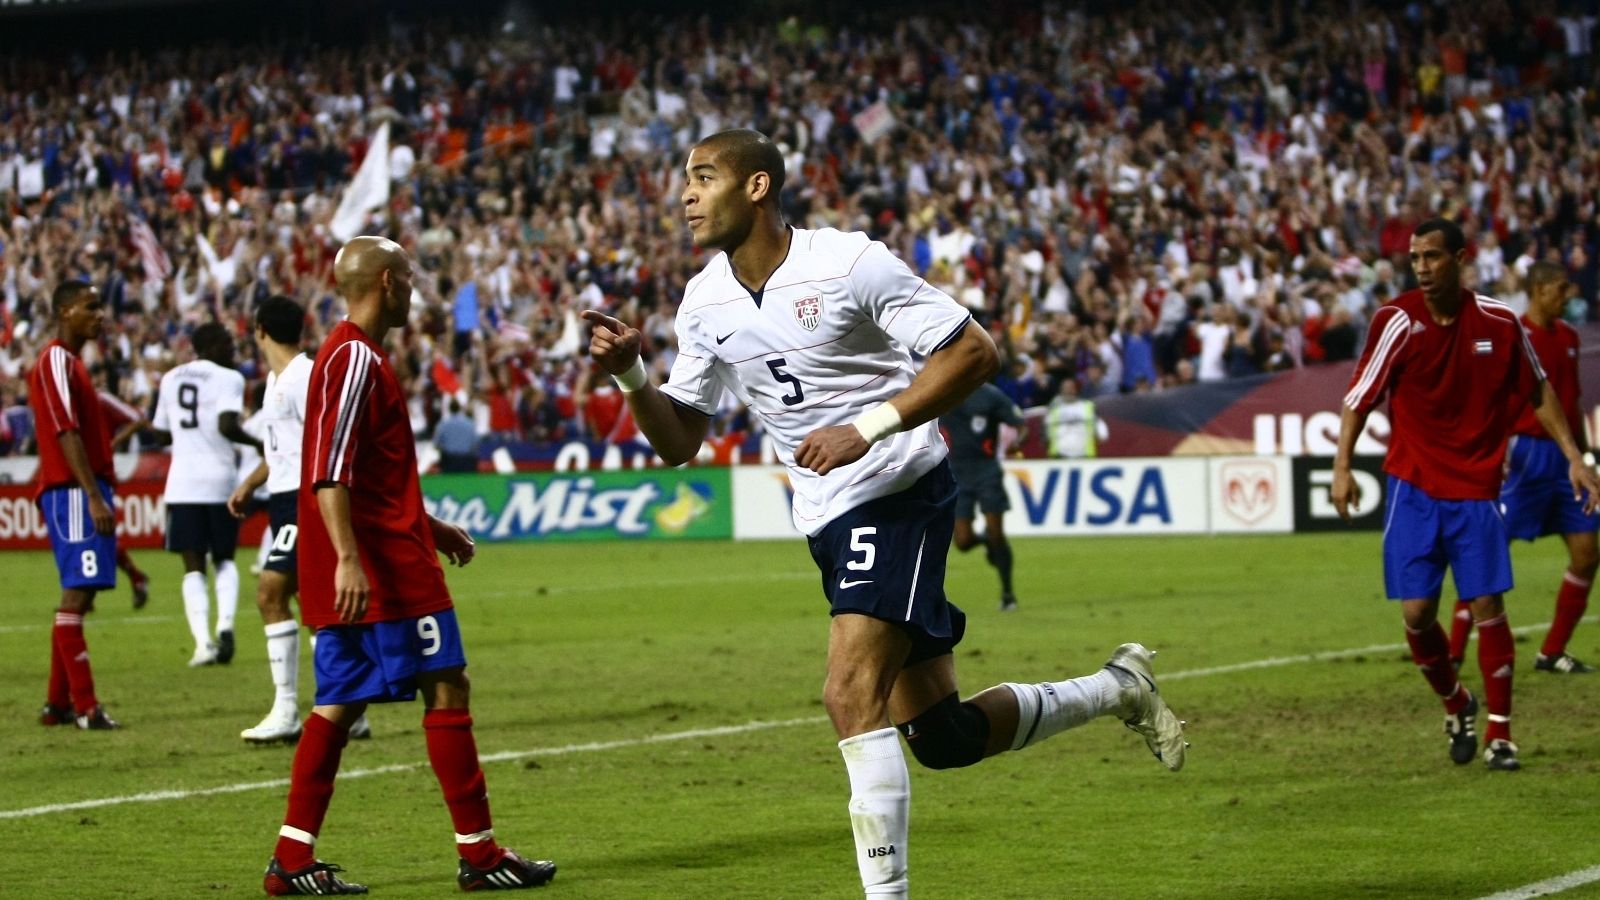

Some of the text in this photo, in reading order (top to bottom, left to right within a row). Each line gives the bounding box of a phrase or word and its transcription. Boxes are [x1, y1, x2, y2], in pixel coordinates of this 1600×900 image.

[766, 358, 805, 406] 5
[178, 382, 199, 429] 9
[491, 476, 660, 538] Mist
[1005, 466, 1172, 527] VISA
[81, 550, 98, 578] 8
[846, 527, 877, 571] 5
[416, 615, 442, 656] 9
[867, 844, 896, 859] USA
